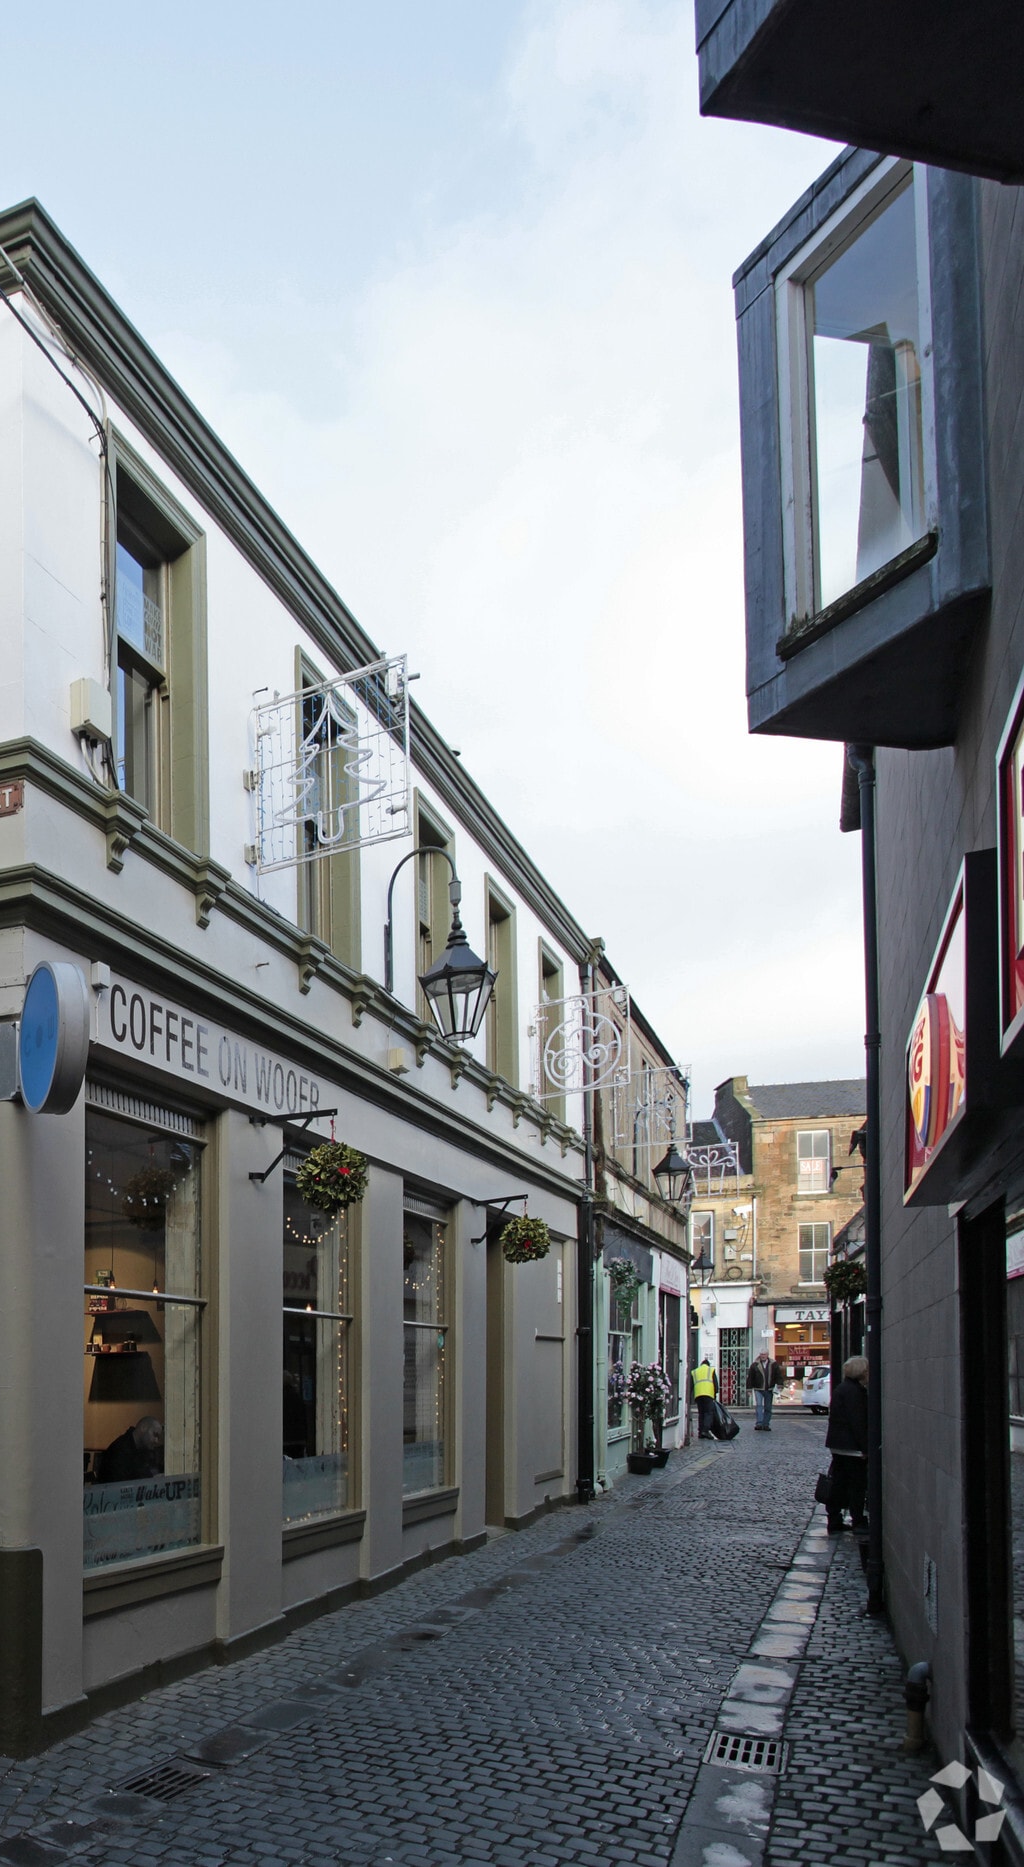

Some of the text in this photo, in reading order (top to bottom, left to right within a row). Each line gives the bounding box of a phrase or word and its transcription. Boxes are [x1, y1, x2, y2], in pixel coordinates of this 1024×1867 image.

[110, 984, 320, 1127] COFFEE ON WOOER
[799, 1161, 821, 1172] SALE
[795, 1310, 831, 1321] TAY
[135, 1483, 166, 1502] Wake
[165, 1480, 187, 1502] UP
